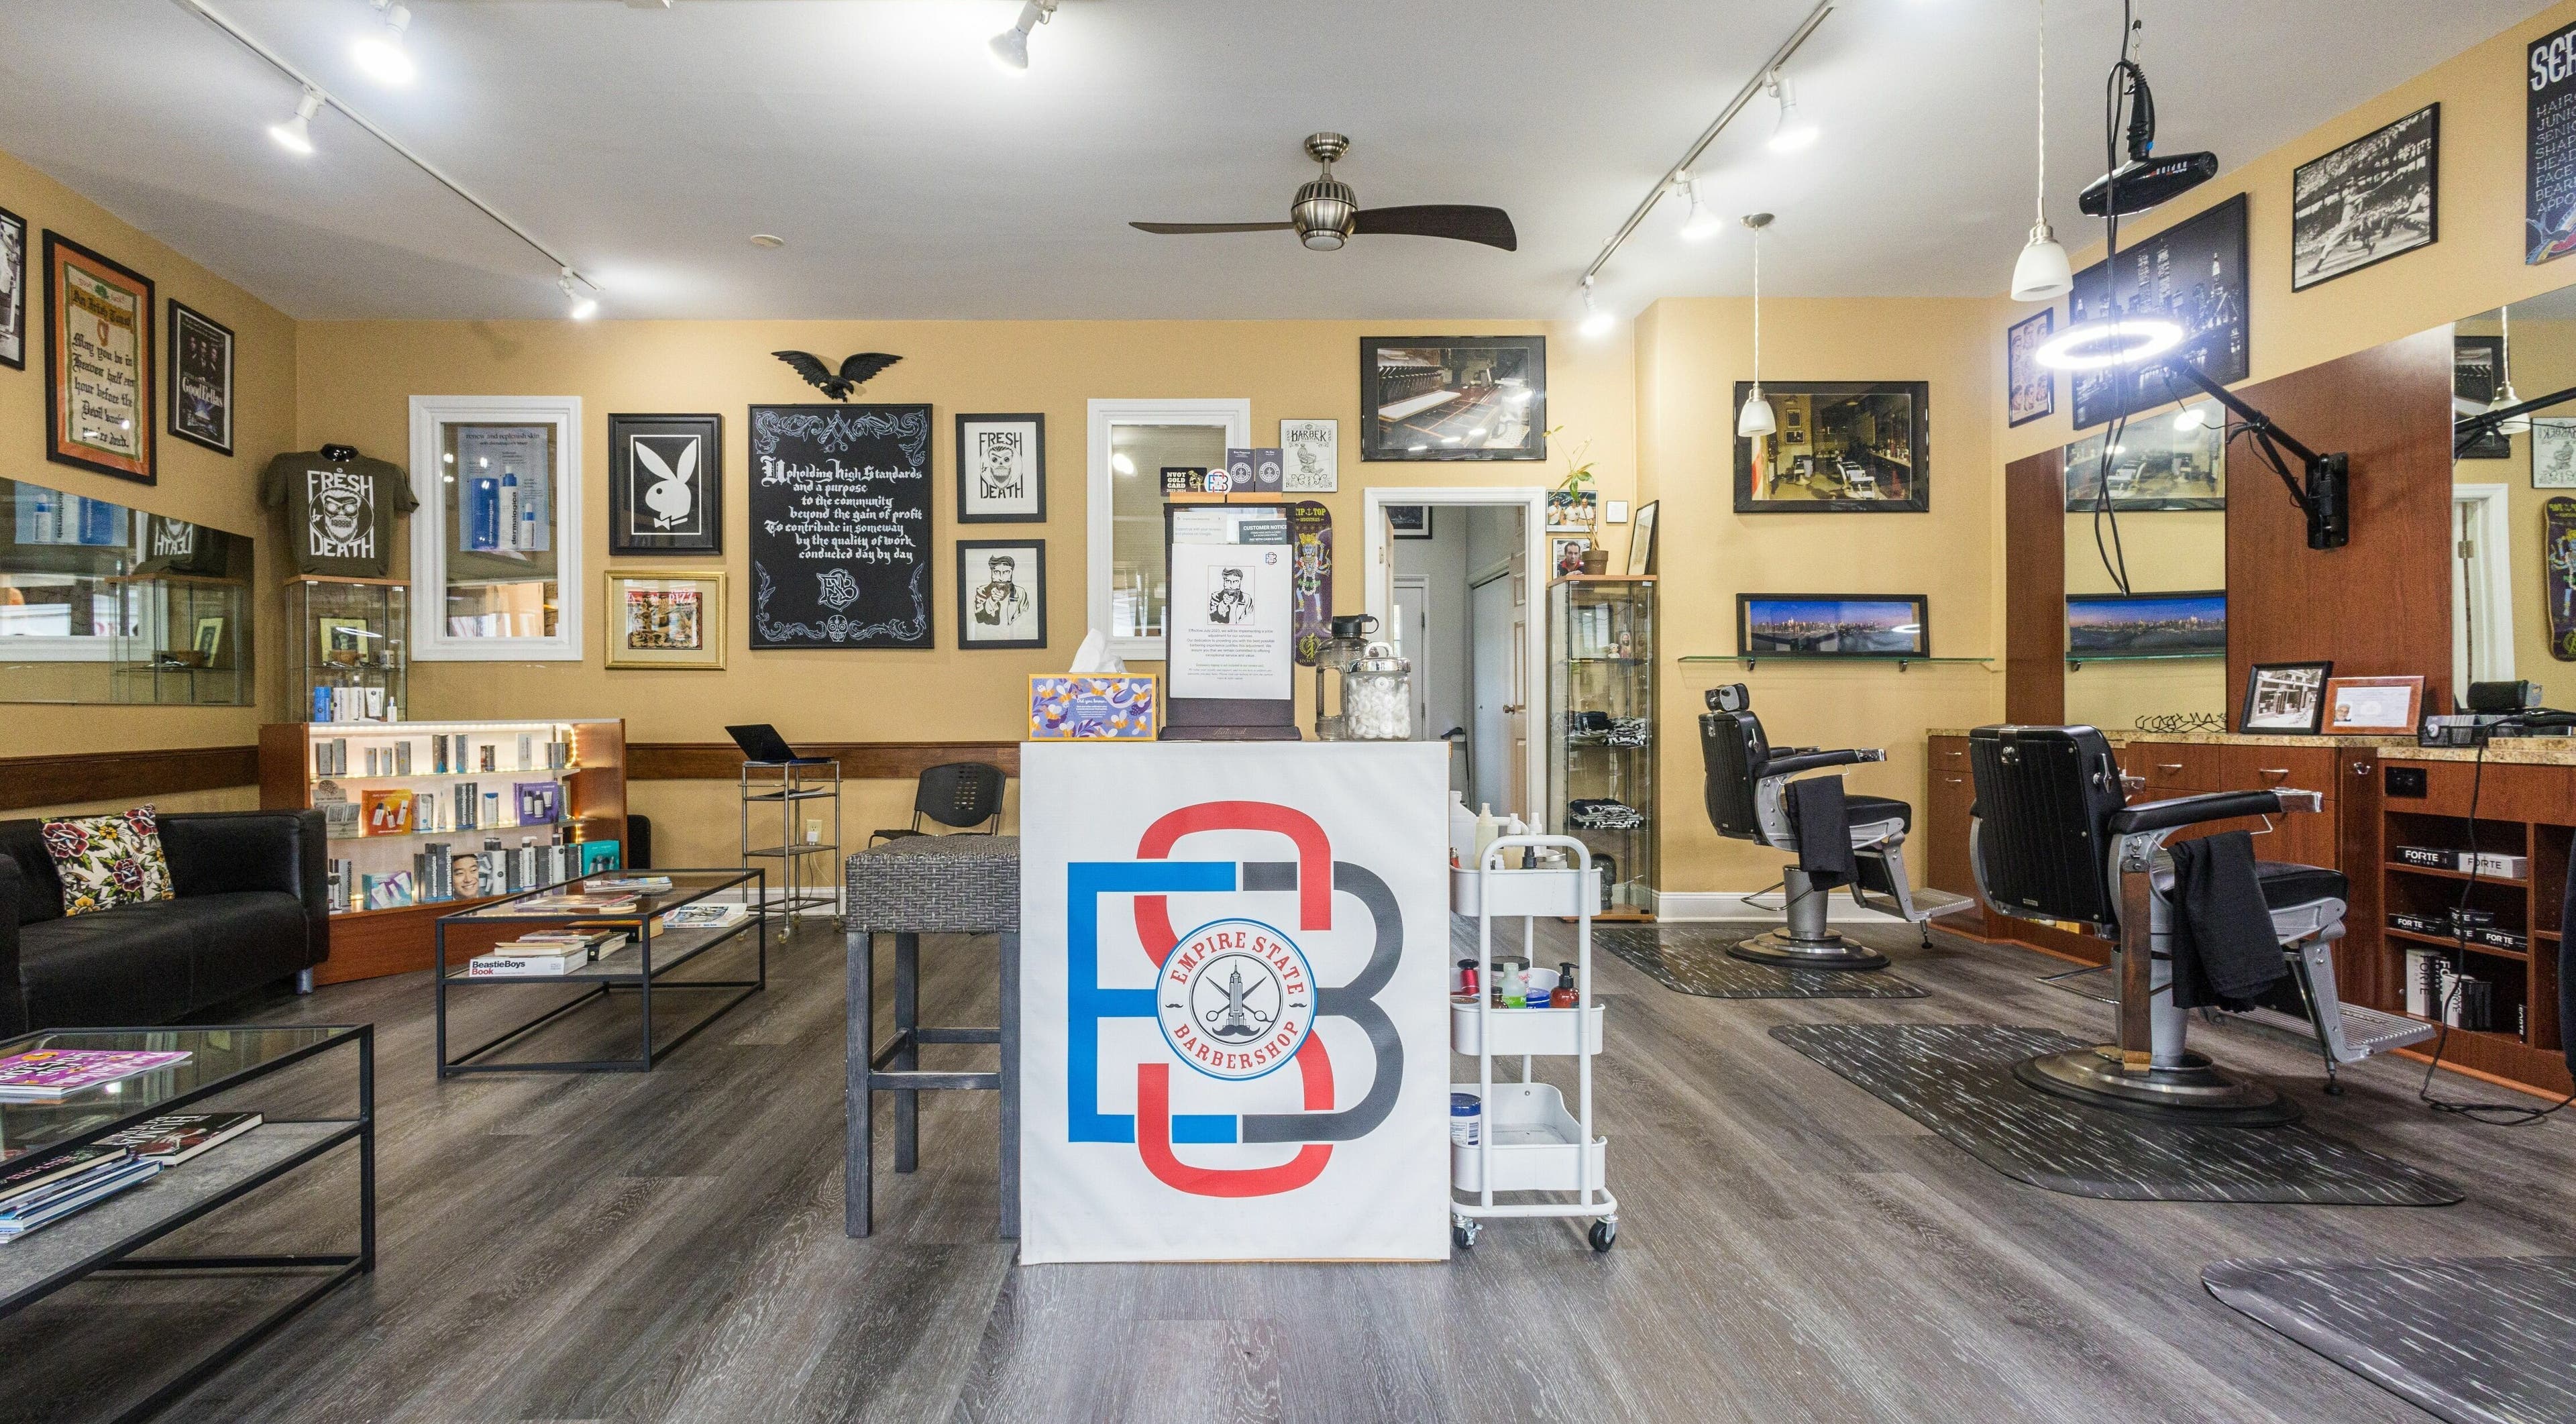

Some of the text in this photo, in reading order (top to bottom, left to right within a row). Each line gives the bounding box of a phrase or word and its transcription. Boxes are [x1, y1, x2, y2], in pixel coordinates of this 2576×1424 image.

[2536, 164, 2573, 187] FACE
[72, 333, 133, 366] May you be in
[72, 353, 103, 378] Heaven
[107, 368, 123, 385] half
[74, 376, 133, 408] hour before the
[81, 399, 103, 420] Devil
[979, 432, 1022, 457] FRESH
[760, 455, 833, 488] Upholding
[861, 465, 922, 484] Standards
[981, 462, 987, 472] to
[307, 470, 374, 508] FRESH
[793, 480, 868, 498] and a purpose
[980, 473, 1024, 498] DEATH
[800, 494, 894, 508] to the community
[1313, 508, 1326, 516] TOP
[312, 508, 323, 523] to
[789, 506, 922, 524] beyond the gain of profit
[764, 520, 904, 537] To contribute in someway
[309, 523, 375, 559] DEATH
[796, 533, 916, 551] by the quality of work
[799, 547, 913, 565] conducted day by day
[2406, 850, 2438, 862] FORTE
[2398, 918, 2423, 928] FORTE
[2486, 933, 2513, 944] FORTE
[1170, 931, 1305, 996] EMPIRE STATE
[2420, 955, 2429, 994] FORTE
[1173, 1020, 1299, 1070] BARBERSHOP
[120, 1115, 199, 1148] HUMA
